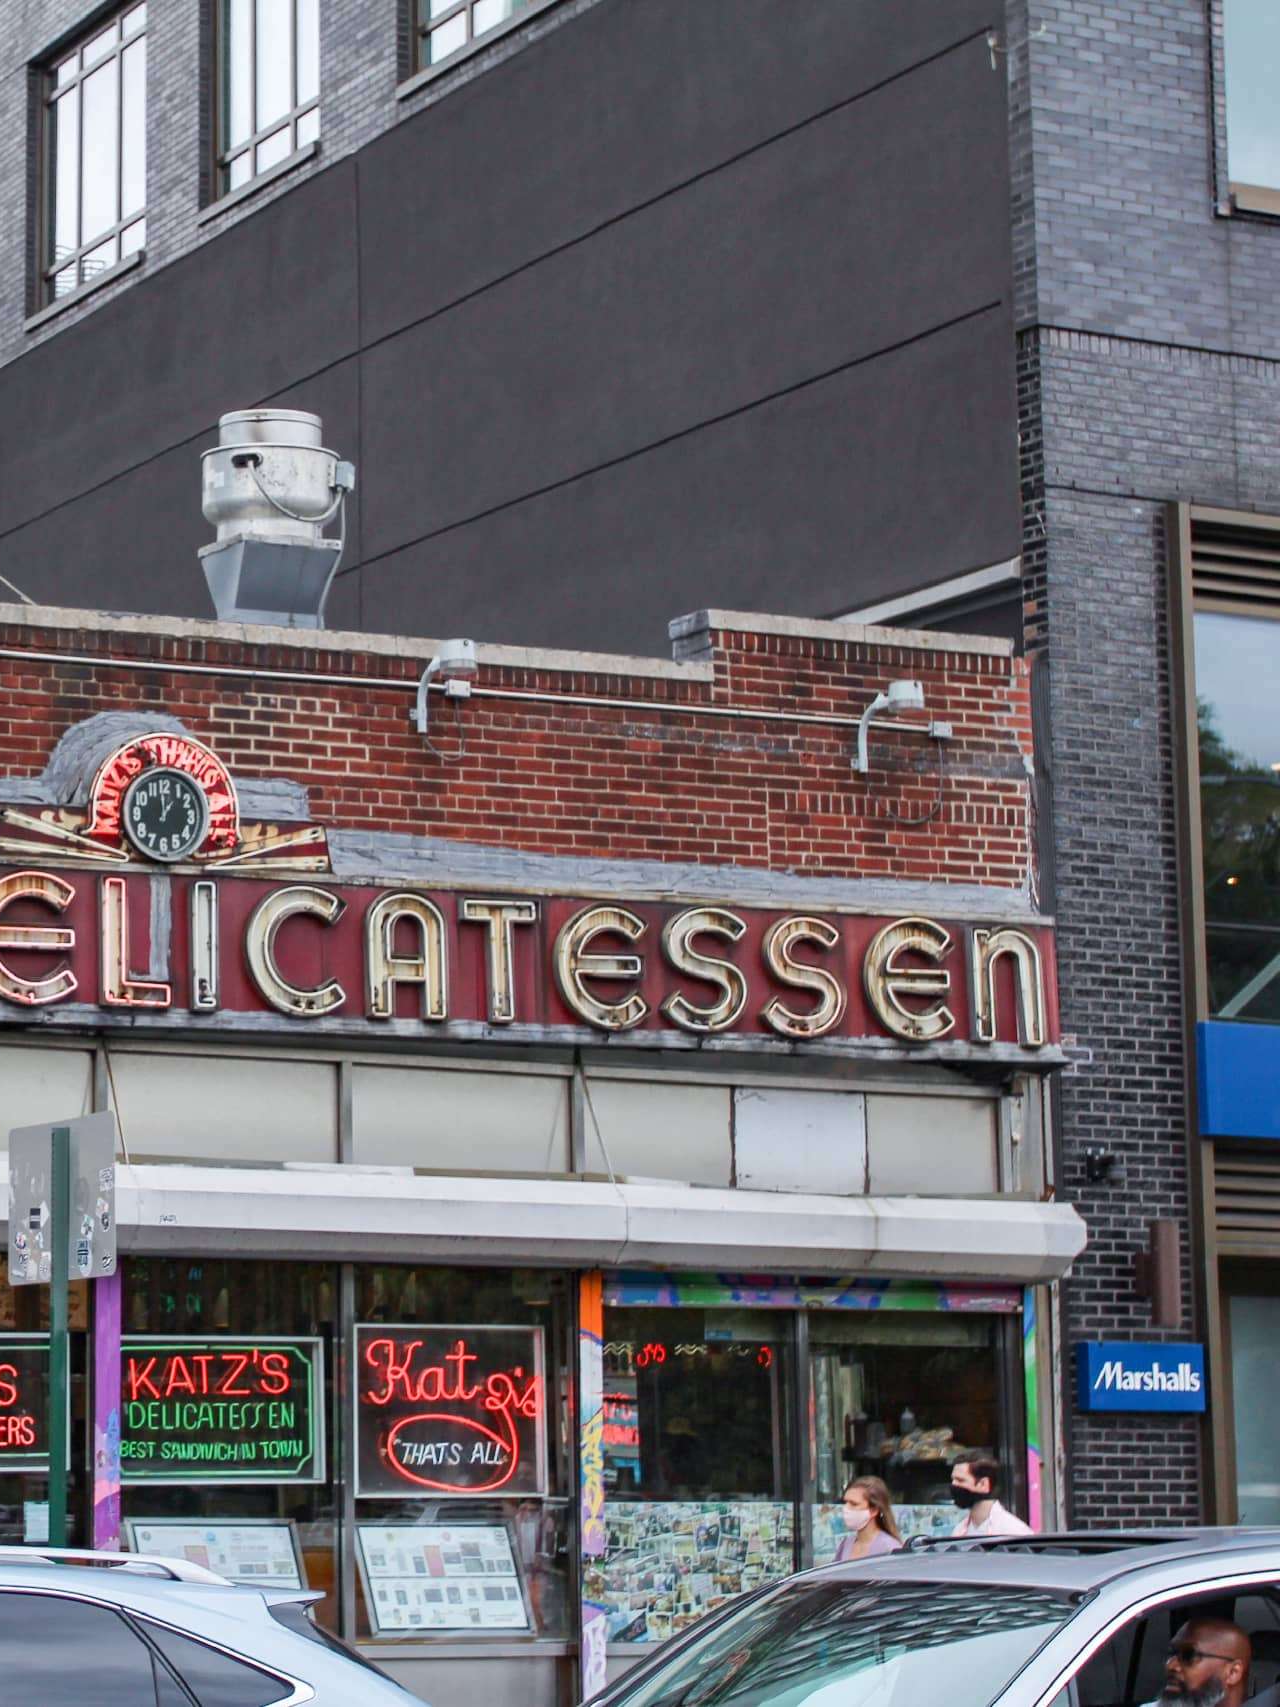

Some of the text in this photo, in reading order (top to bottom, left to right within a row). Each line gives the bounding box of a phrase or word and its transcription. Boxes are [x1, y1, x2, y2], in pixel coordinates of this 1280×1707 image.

[148, 782, 157, 797] 11
[158, 779, 170, 794] 12
[175, 783, 181, 799] 1
[136, 791, 148, 807] 10
[182, 793, 191, 809] 2
[132, 806, 141, 822] 9
[186, 810, 195, 825] 3
[137, 823, 146, 838] 8
[182, 825, 190, 840] 4
[147, 833, 157, 848] 7
[159, 837, 168, 852] 6
[171, 834, 180, 849] 5
[129, 1347, 291, 1401] KATZ'S
[1093, 1360, 1201, 1393] Marshalls
[128, 1401, 295, 1430] DELICATESSEN
[120, 1439, 304, 1462] BEST SANDWICH IN TOWN
[470, 1442, 506, 1465] ALL
